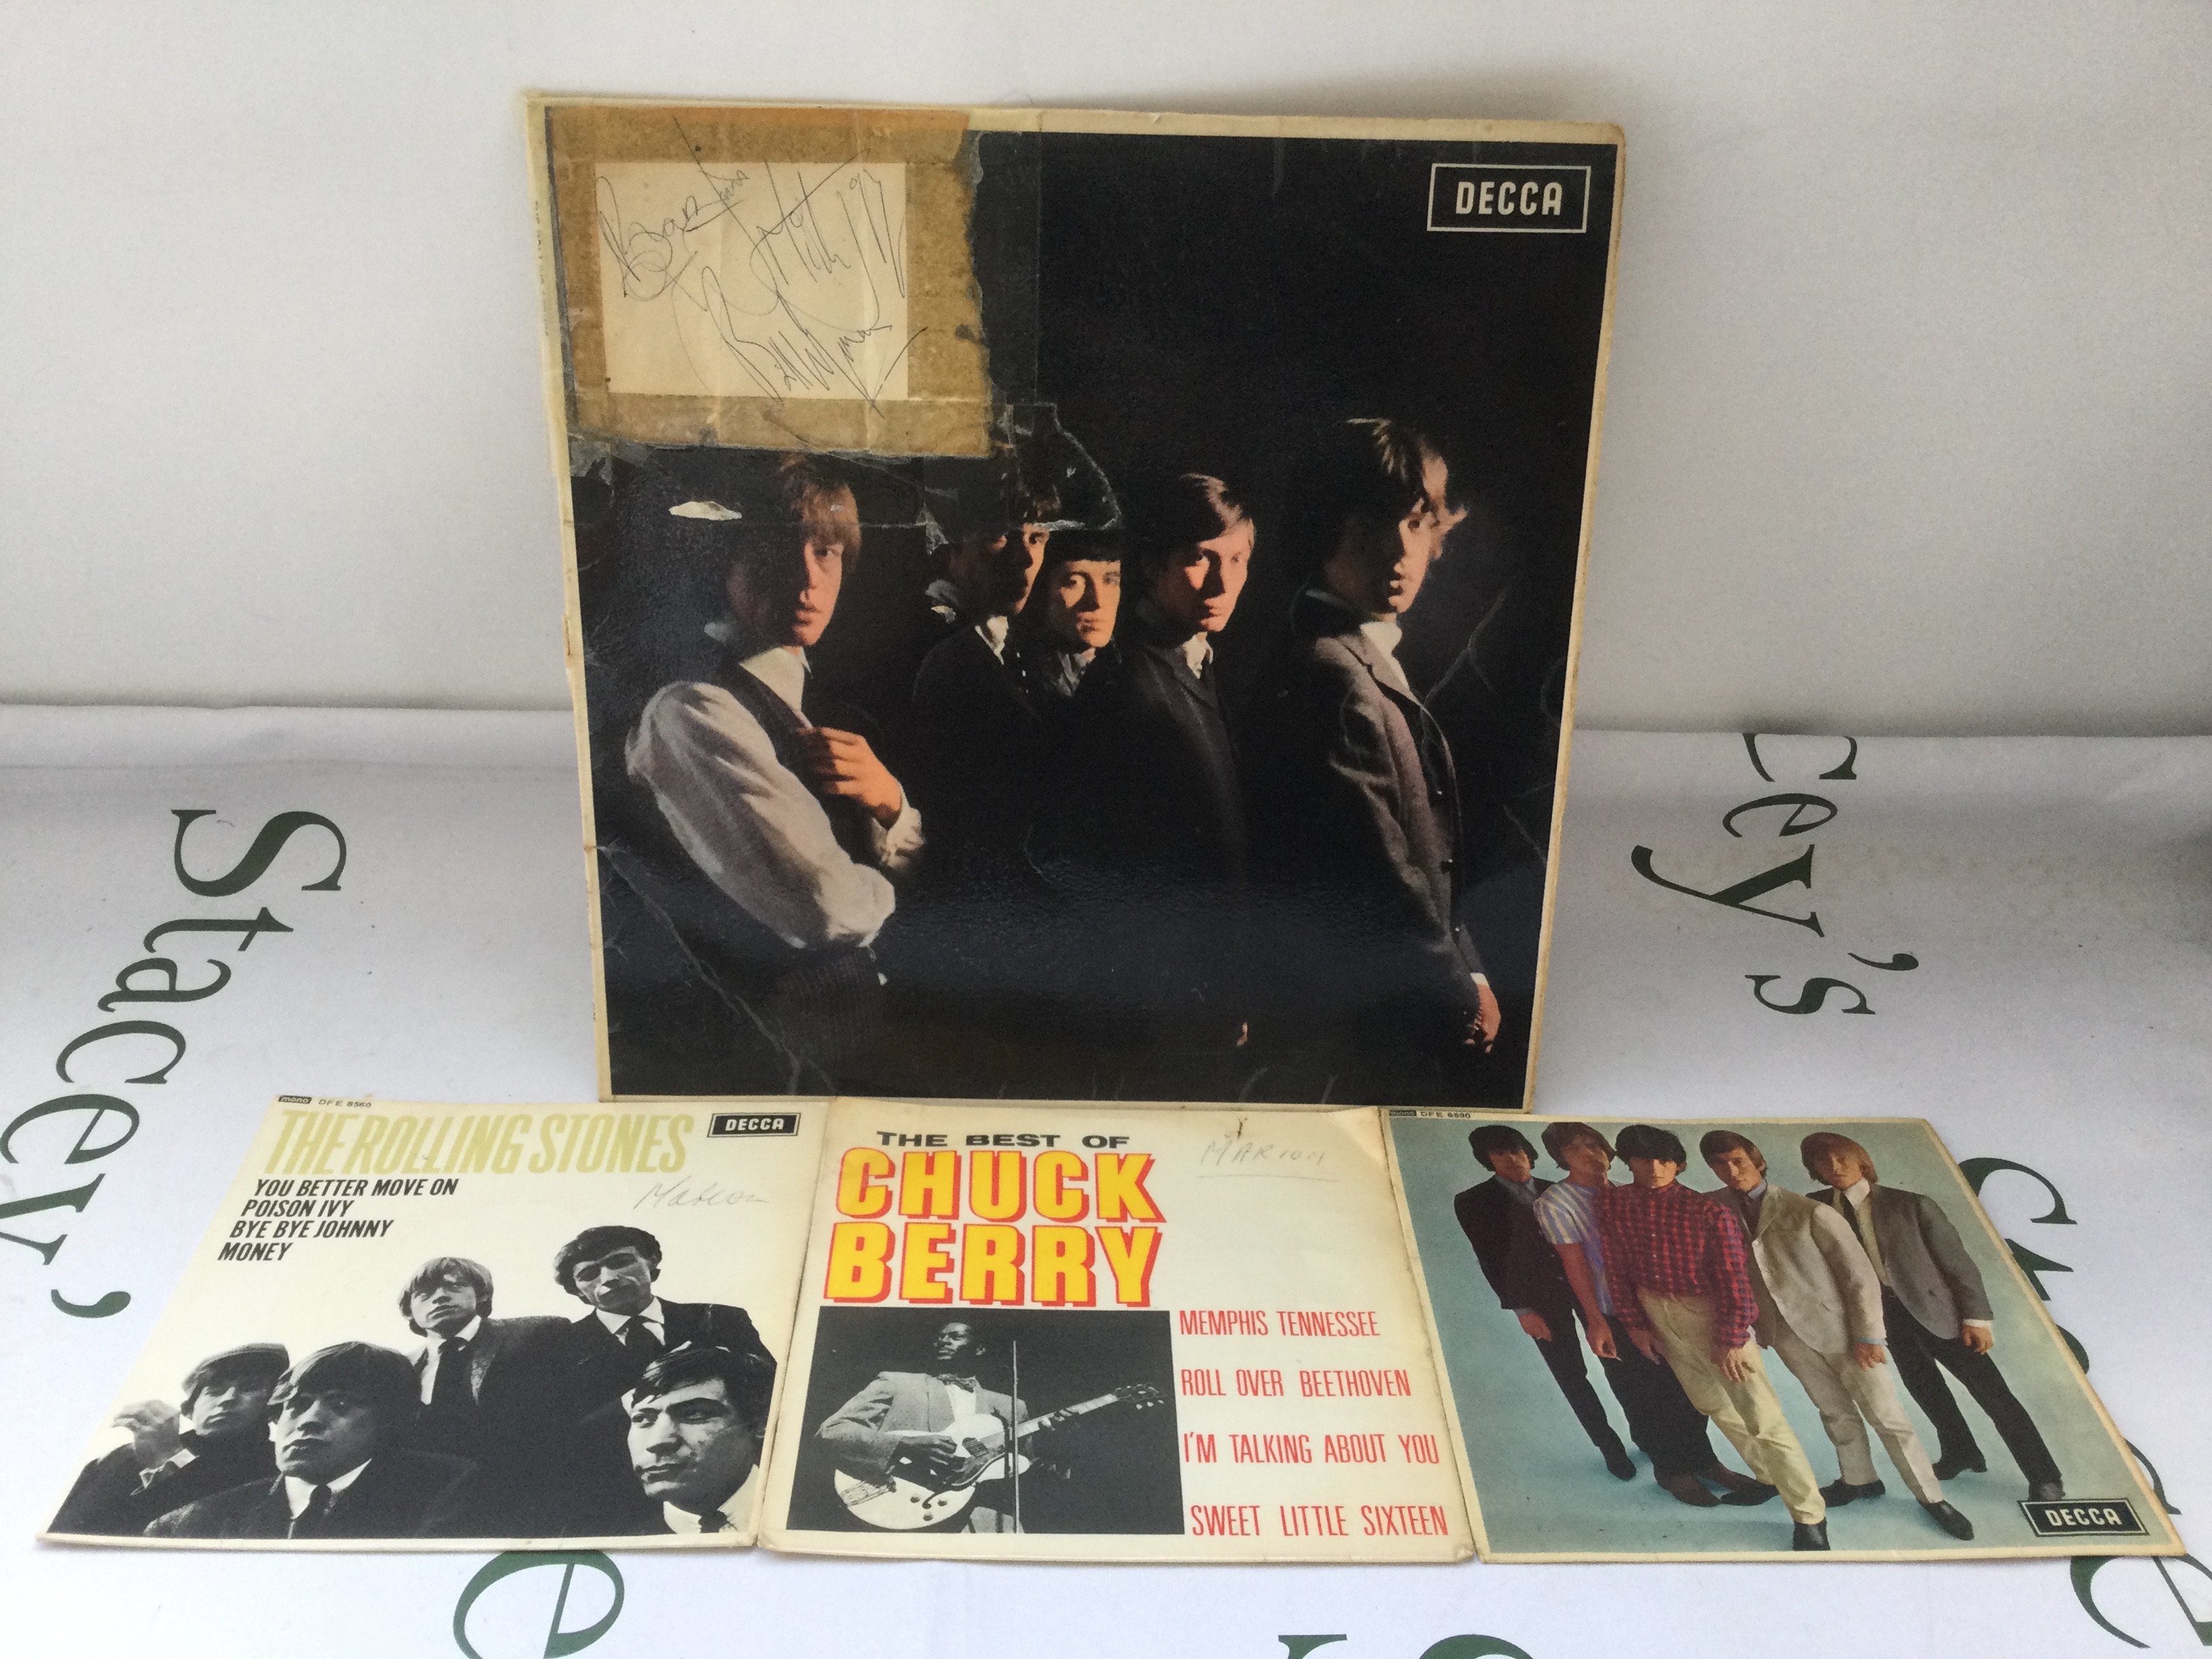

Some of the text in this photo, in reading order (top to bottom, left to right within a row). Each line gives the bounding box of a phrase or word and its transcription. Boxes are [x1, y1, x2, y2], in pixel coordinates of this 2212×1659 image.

[1455, 181, 1563, 216] DECCA
[725, 1118, 785, 1132] DECCA
[264, 1109, 695, 1175] THE ROLLING STONES
[876, 1131, 1130, 1149] THE BEST OF
[254, 1179, 459, 1196] YOU BETTER MOVE ON
[836, 1147, 1167, 1223] CHUCK
[241, 1200, 355, 1217] POISON IVY
[229, 1220, 394, 1238] BYE BYE JOHNNY
[217, 1242, 294, 1261] MONEY
[823, 1222, 1163, 1308] BERRY
[1180, 1310, 1380, 1336] MEMPHIS TENNESSEE
[1181, 1369, 1412, 1397] ROLL OVER BEETHOVEN
[1183, 1431, 1440, 1464] I'M TALKING ABOUT YOU
[1191, 1504, 1449, 1536] SWEET LITTLE SIXTEEN
[2045, 1508, 2123, 1526] DECCA
